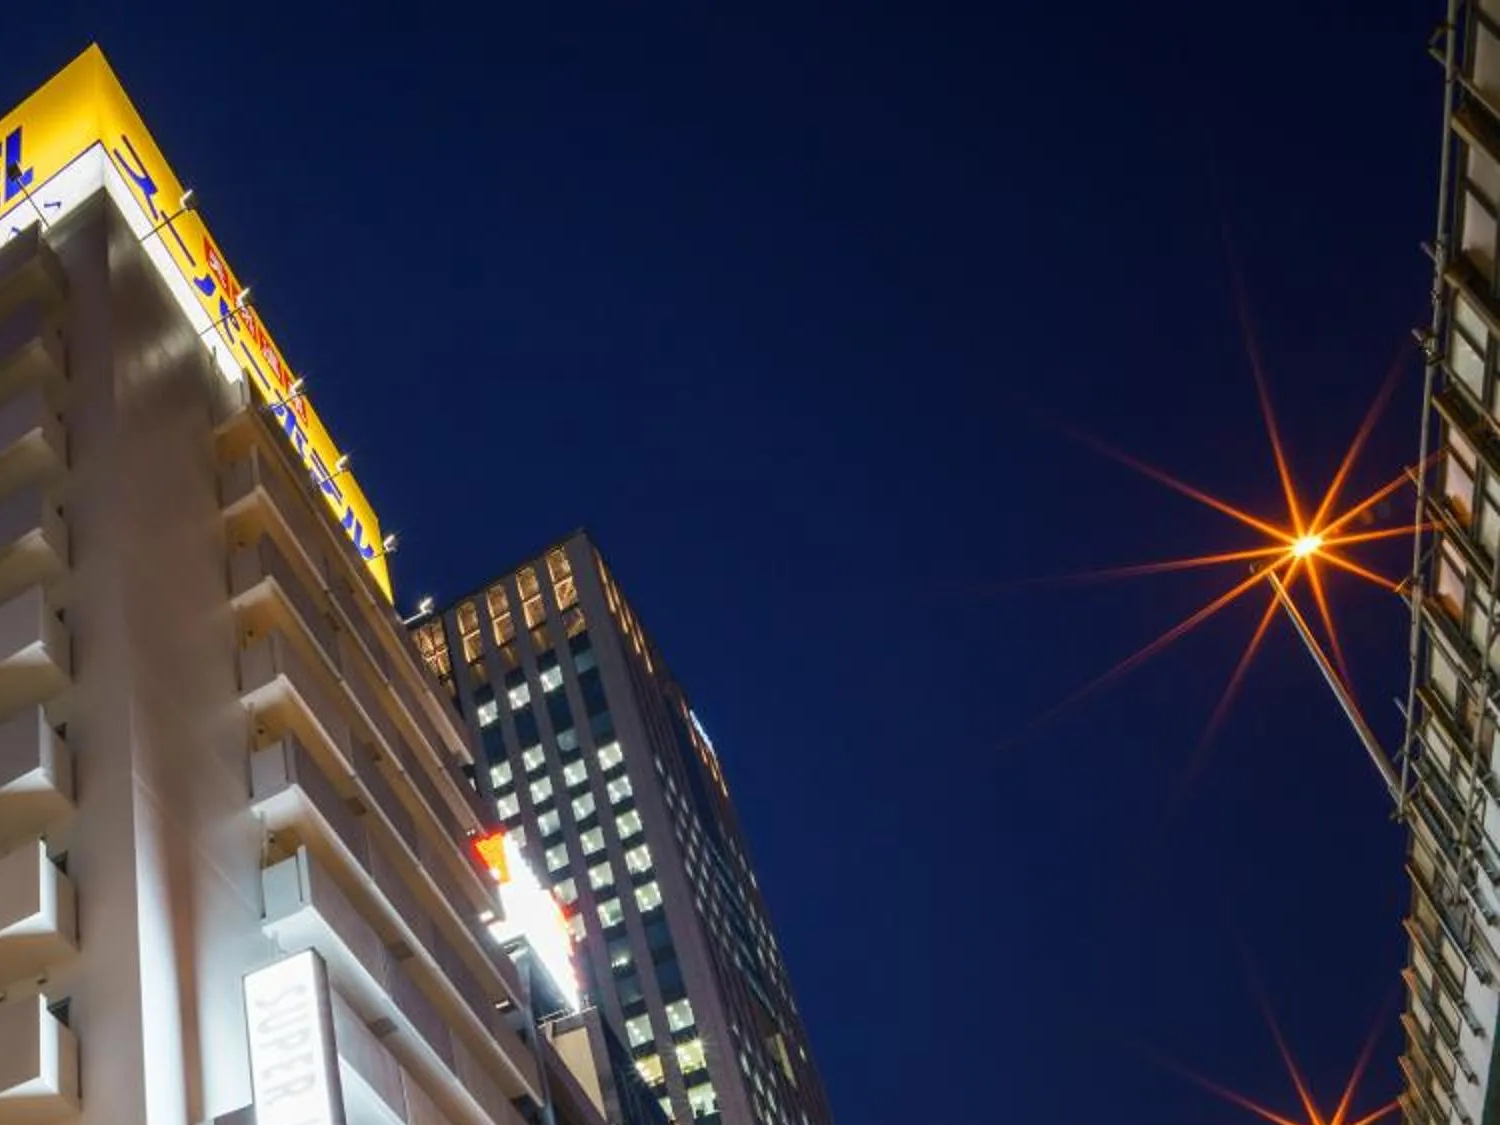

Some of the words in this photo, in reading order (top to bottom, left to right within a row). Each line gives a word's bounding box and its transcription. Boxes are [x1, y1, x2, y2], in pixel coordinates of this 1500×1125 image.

[113, 134, 375, 560] スーパーホテル
[255, 984, 316, 1105] SUPER
